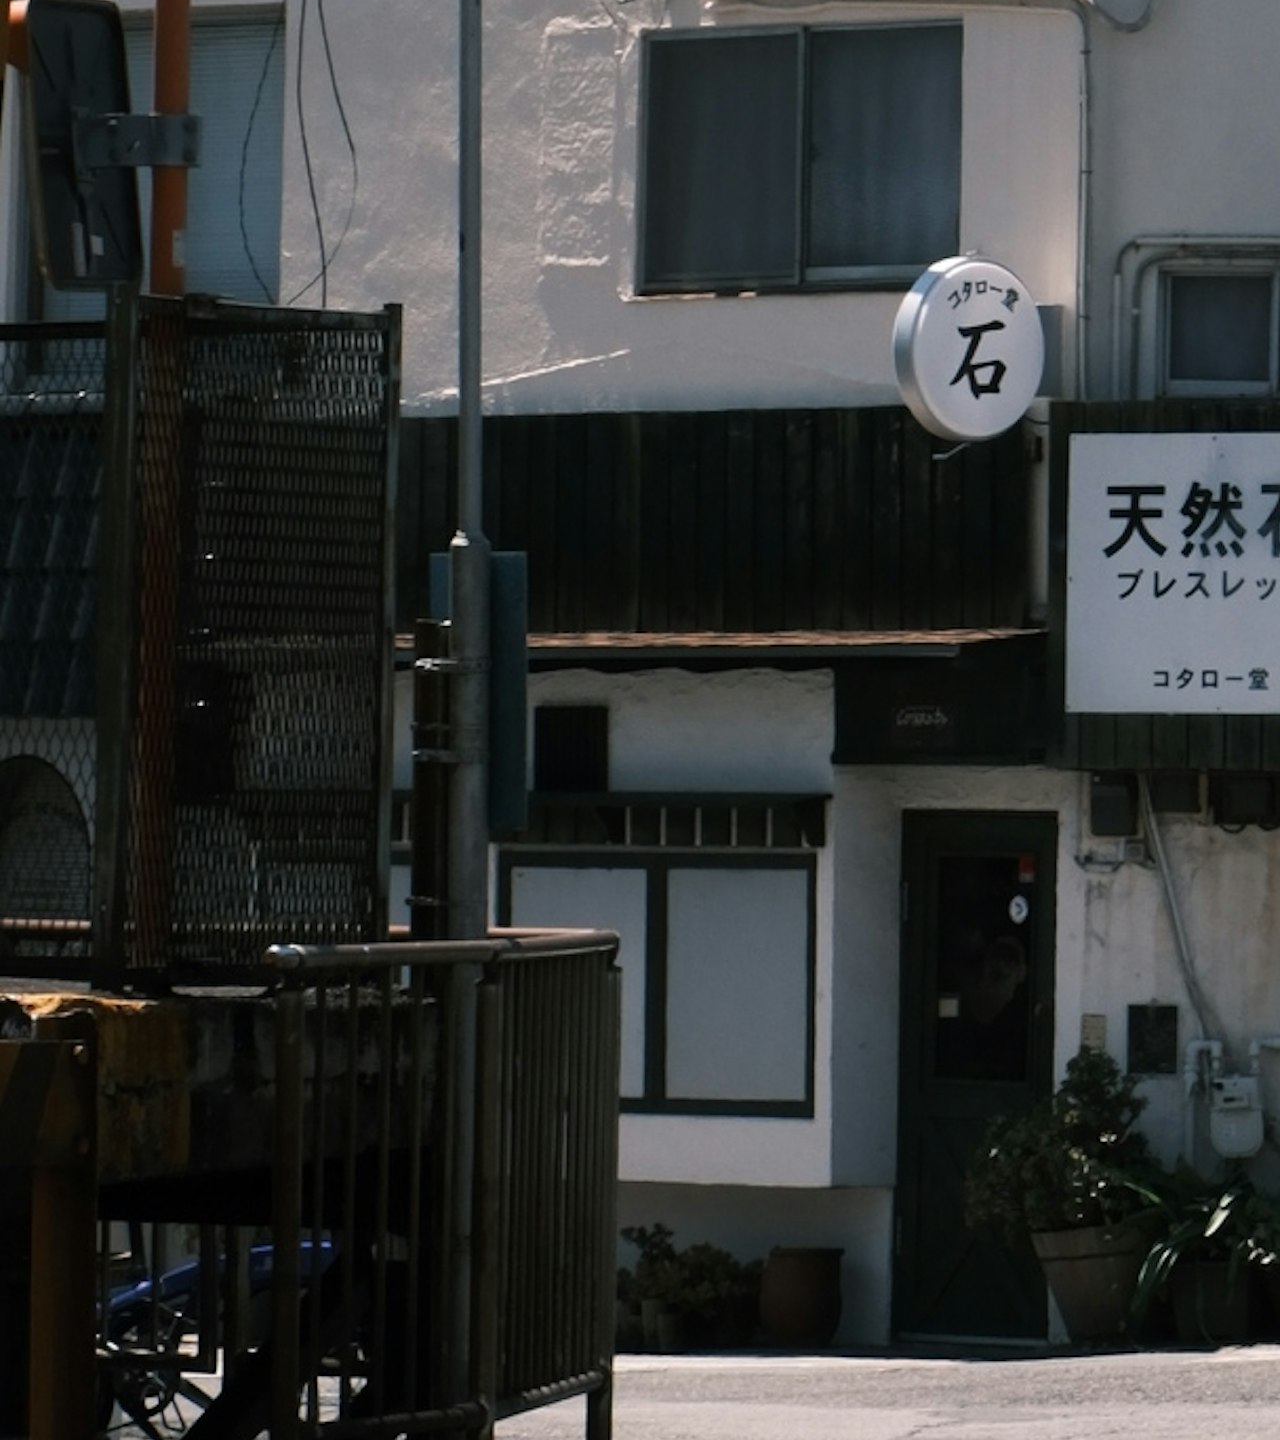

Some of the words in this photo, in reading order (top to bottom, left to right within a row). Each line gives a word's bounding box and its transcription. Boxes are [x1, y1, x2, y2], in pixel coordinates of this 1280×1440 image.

[947, 280, 1020, 313] コタロー堂
[949, 319, 1007, 399] 石
[1152, 667, 1270, 691] コタロー堂
